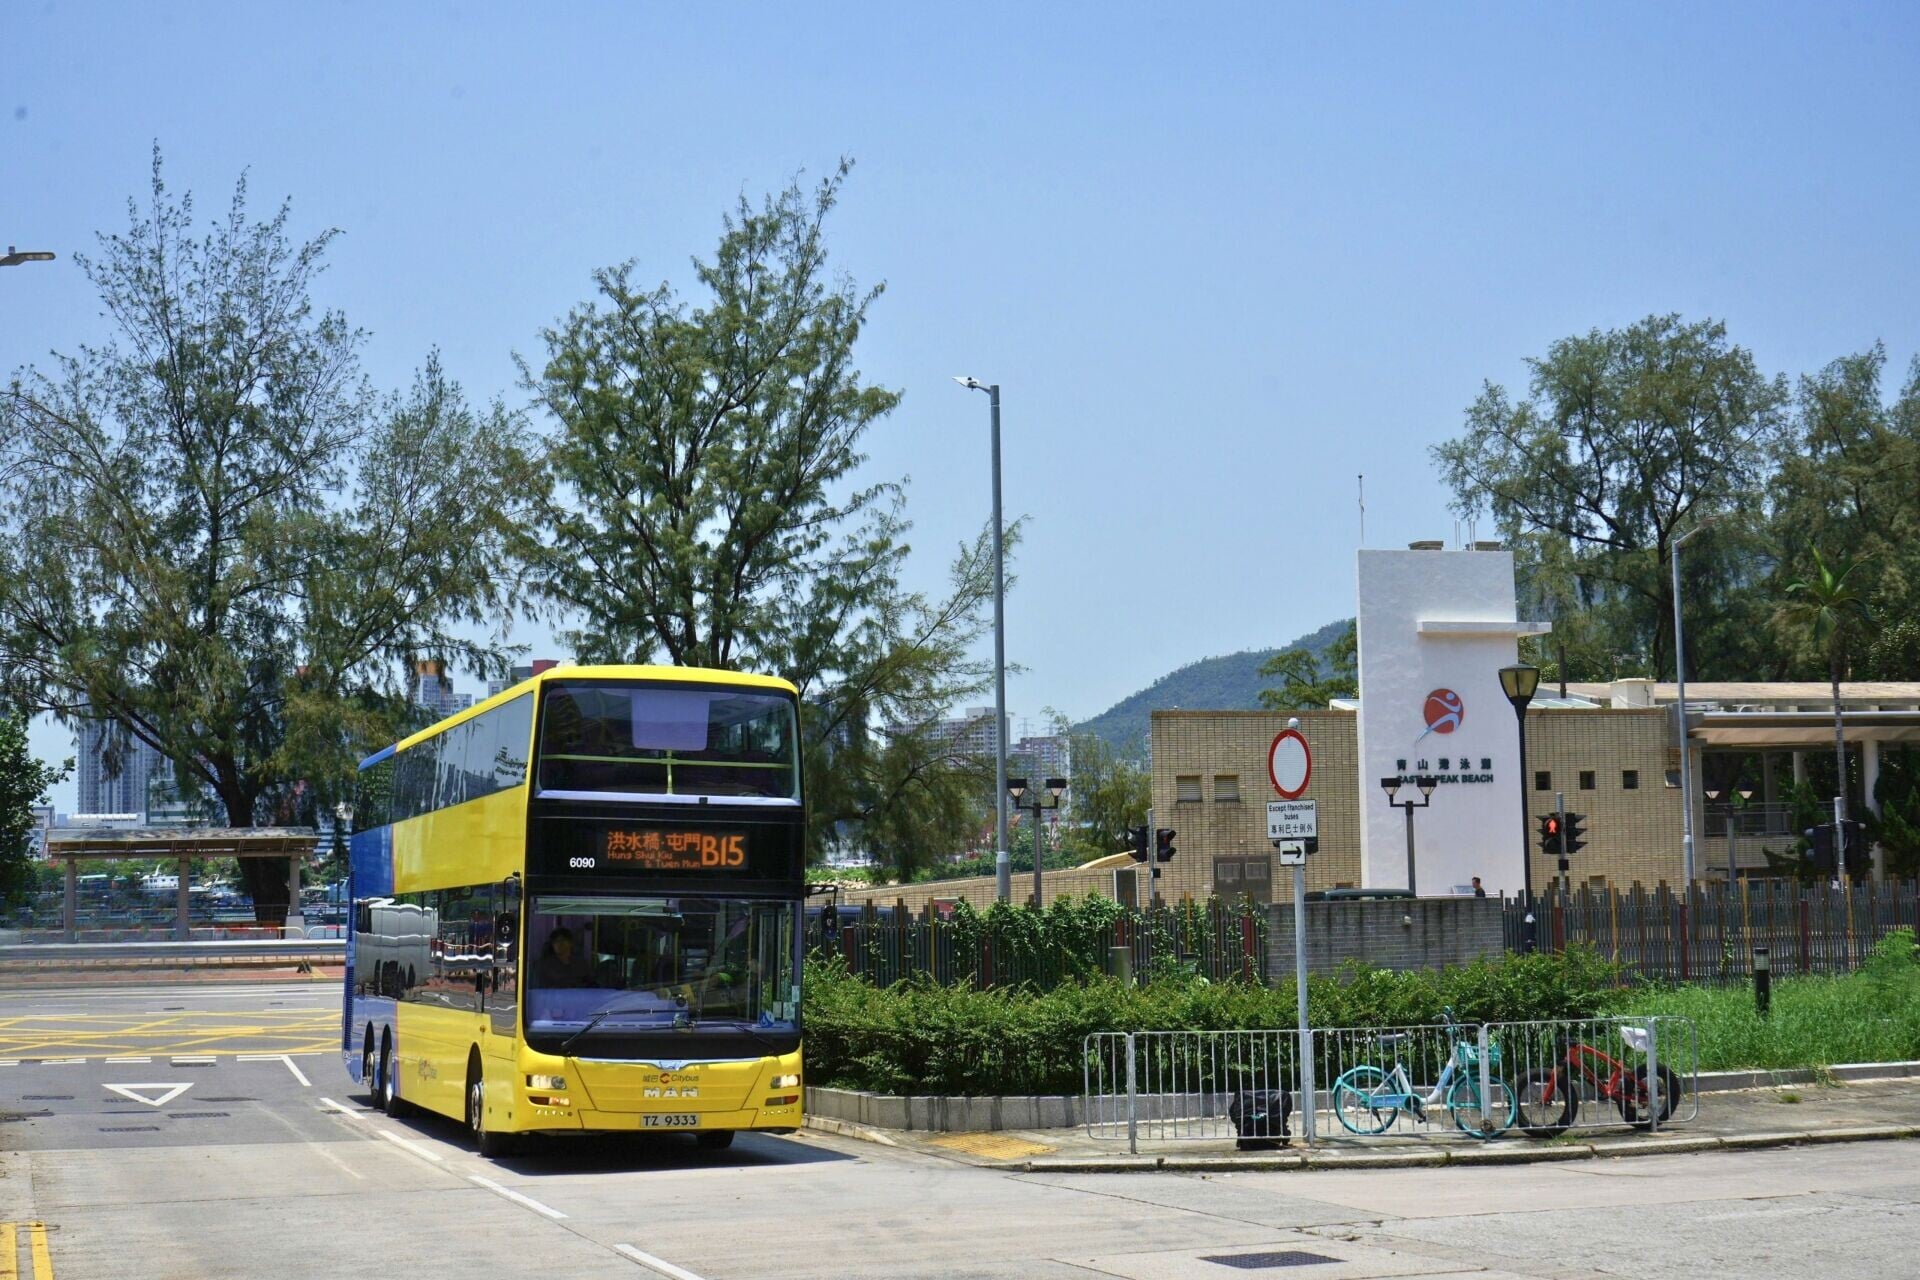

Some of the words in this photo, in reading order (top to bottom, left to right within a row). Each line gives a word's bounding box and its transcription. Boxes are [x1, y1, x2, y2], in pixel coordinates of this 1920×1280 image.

[1434, 774, 1459, 783] PEAK
[1461, 773, 1494, 783] BEACH
[1269, 805, 1287, 813] Except
[1271, 823, 1313, 834] 專利巴士例外
[635, 850, 656, 860] Shui
[702, 835, 745, 866] B15
[569, 857, 595, 868] 6090
[671, 1074, 700, 1083] Citybus
[643, 1087, 699, 1098] MAN
[643, 1115, 659, 1126] TZ
[664, 1115, 697, 1126] 9333
